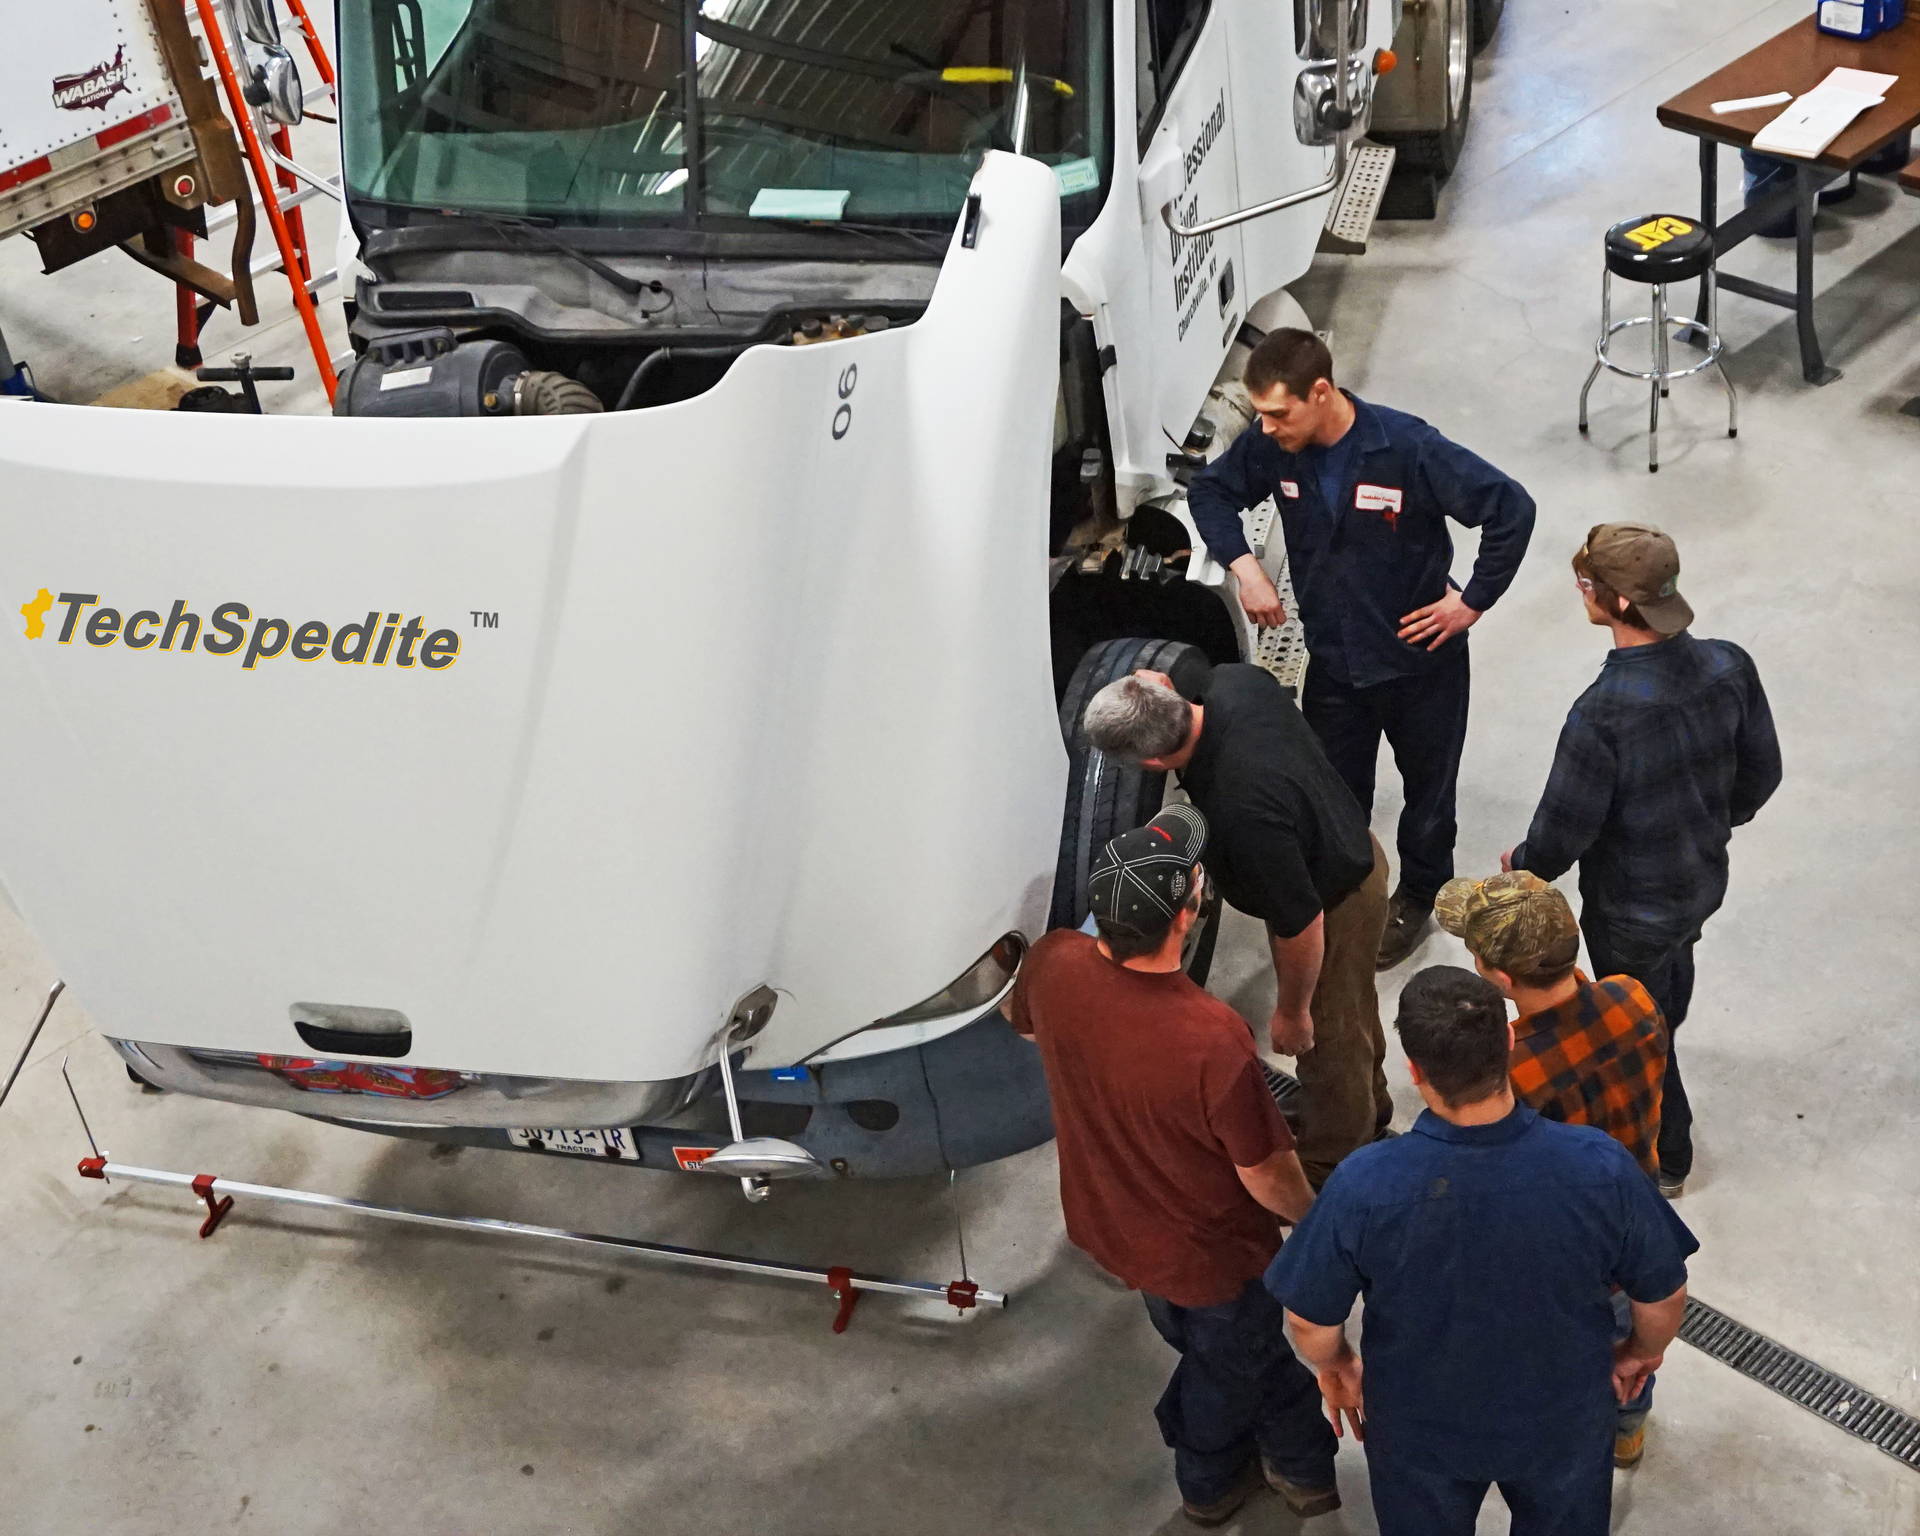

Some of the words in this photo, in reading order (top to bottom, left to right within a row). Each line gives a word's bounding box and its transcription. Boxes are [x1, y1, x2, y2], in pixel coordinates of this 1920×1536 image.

[53, 64, 127, 107] WABASH
[81, 87, 113, 105] NATIONAL
[1623, 216, 1693, 252] CAT
[831, 362, 858, 441] 06
[57, 592, 462, 671] TechSpedite
[555, 1144, 597, 1154] TRACTOR
